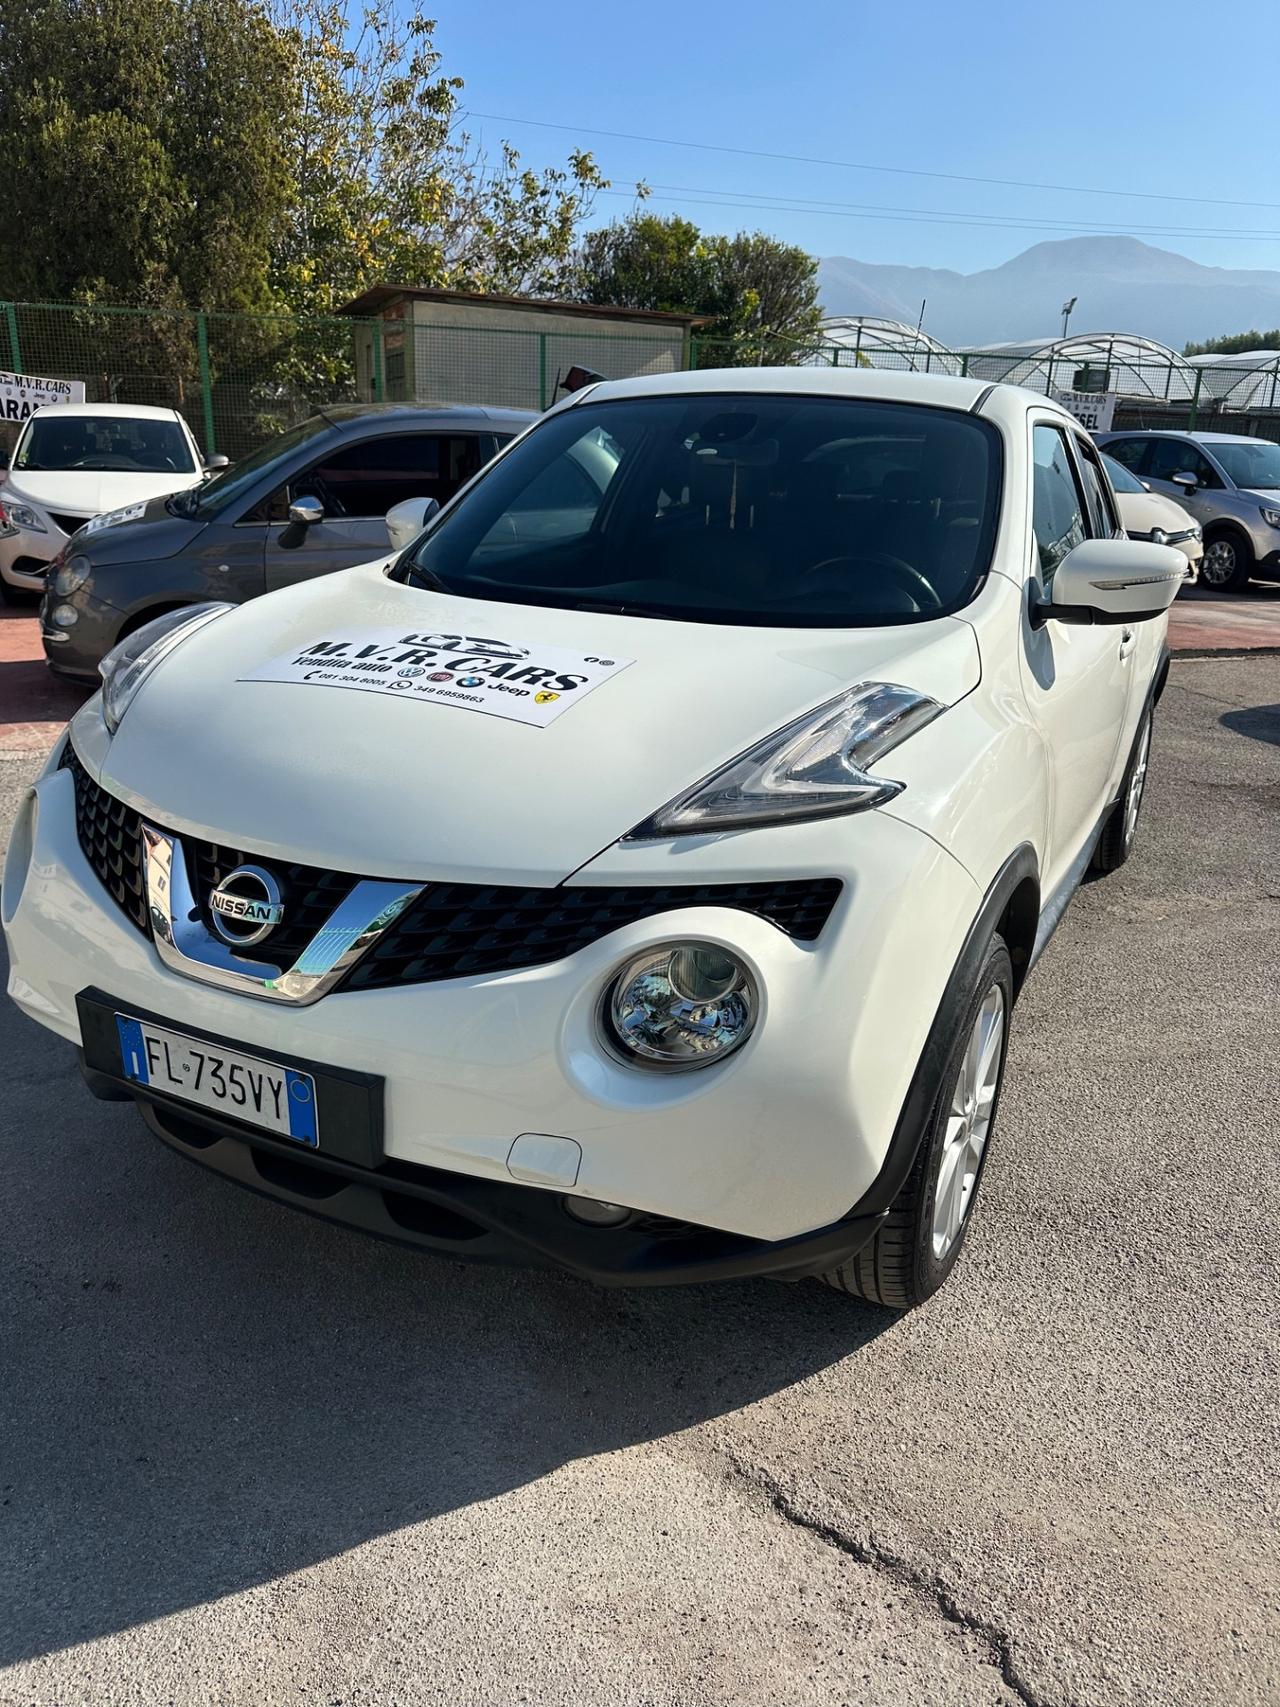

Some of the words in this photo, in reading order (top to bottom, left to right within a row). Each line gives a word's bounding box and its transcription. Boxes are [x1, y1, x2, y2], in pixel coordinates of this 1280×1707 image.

[291, 656, 353, 669] Vendita
[351, 662, 393, 673] auto
[413, 685, 436, 693] 349
[487, 683, 531, 697] Jeep
[211, 894, 272, 920] NISSAN
